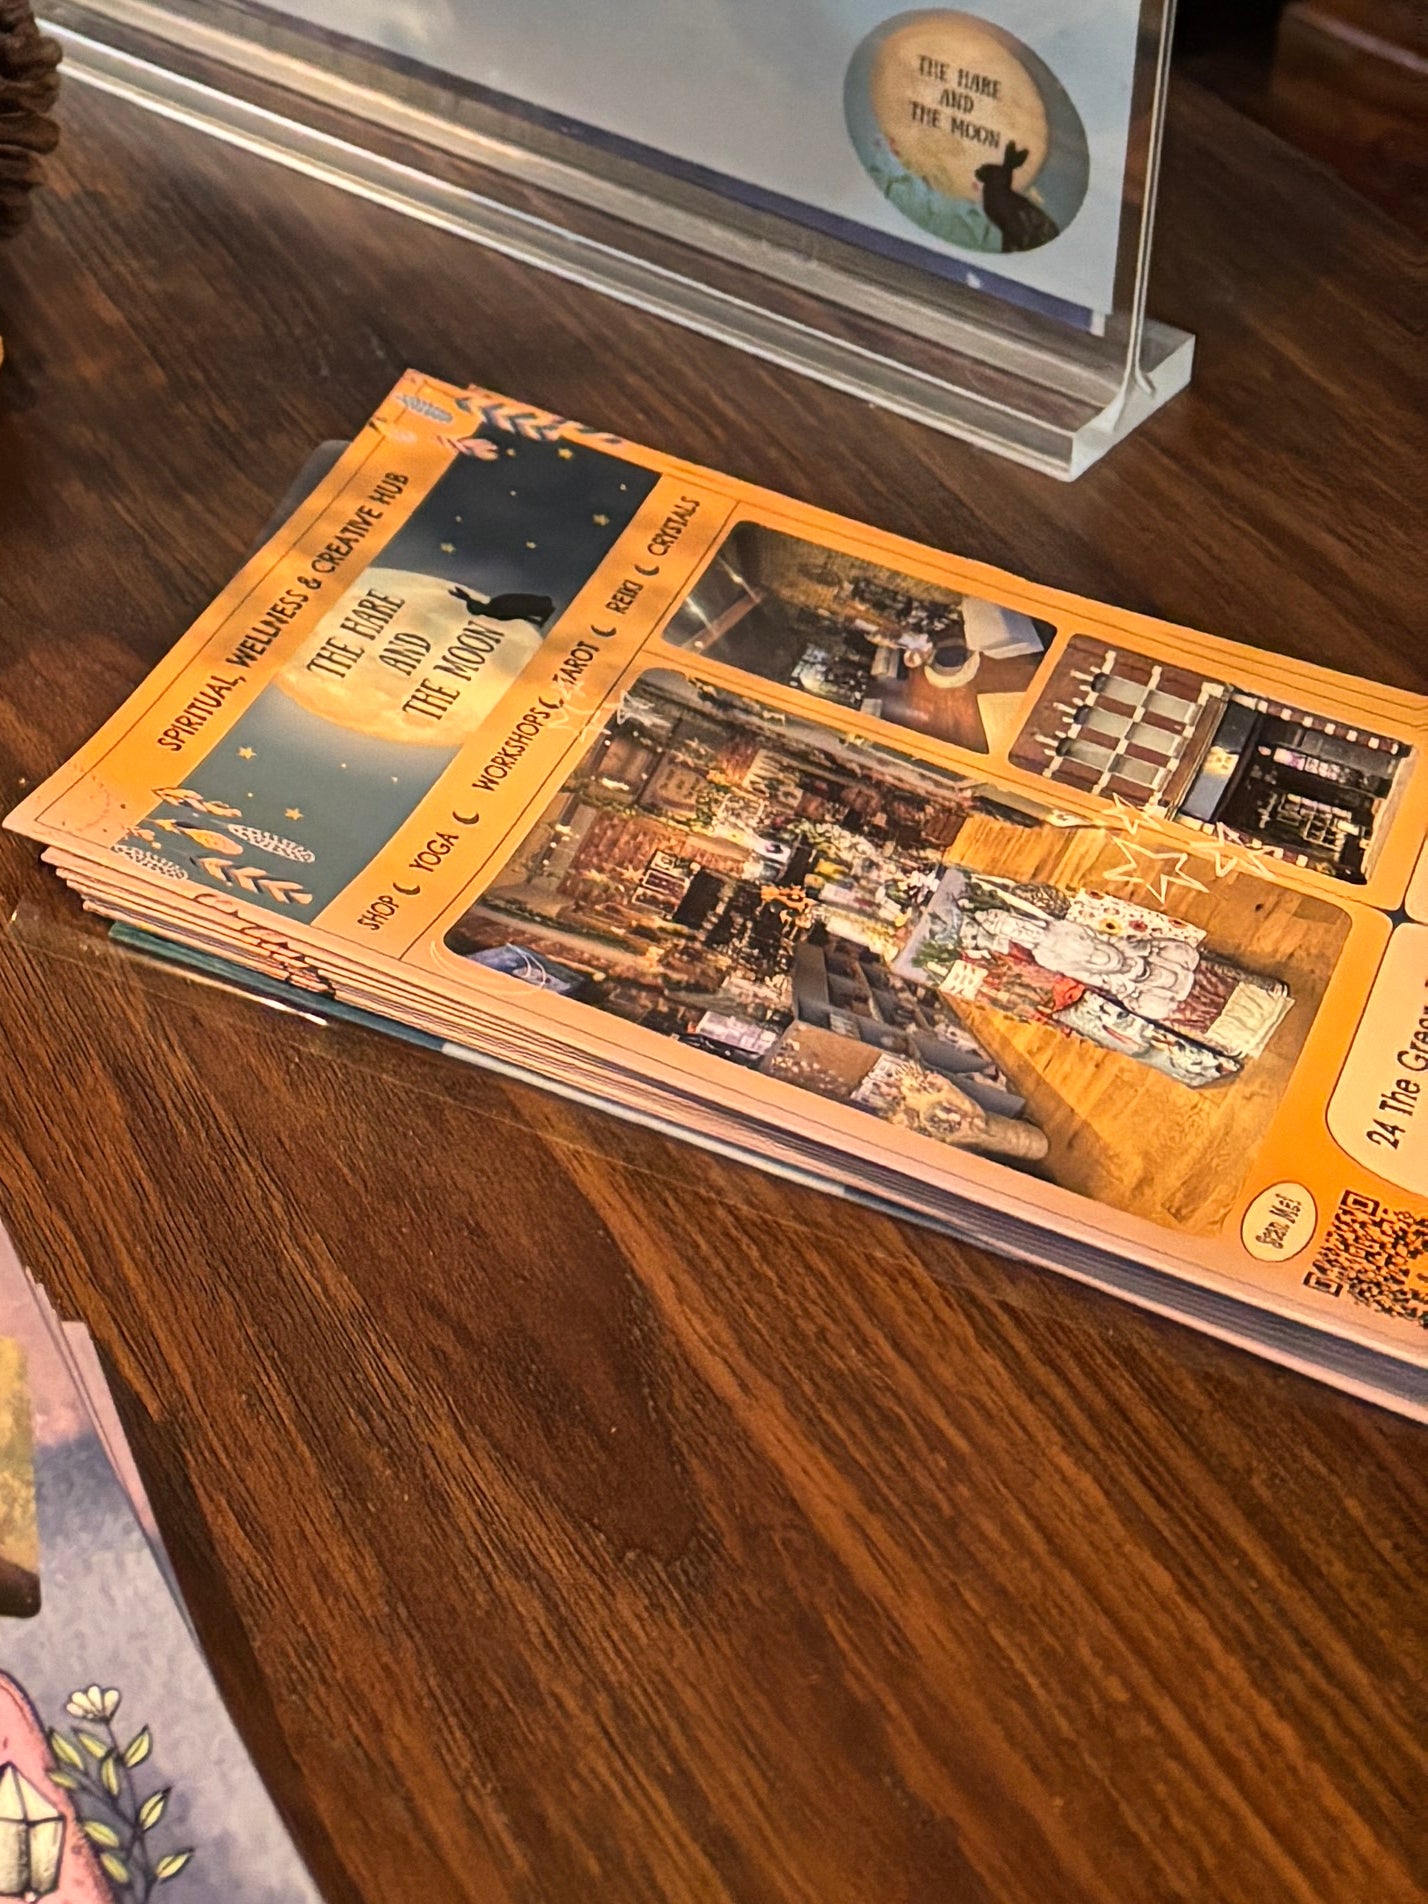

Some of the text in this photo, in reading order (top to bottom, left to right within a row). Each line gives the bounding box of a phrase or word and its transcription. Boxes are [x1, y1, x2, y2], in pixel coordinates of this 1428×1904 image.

[918, 54, 1002, 100] THE HARE
[939, 88, 974, 114] AND
[909, 101, 1001, 149] THE MOON
[157, 471, 409, 752] SPIRITUAL, WELLNESS & CREATIVE HUB
[306, 588, 405, 679] THE HARE
[378, 632, 432, 676] AND
[402, 620, 505, 721] THE MOON
[357, 495, 701, 930] SHOP YOGA WORKSHOPS TAROT REIKI CRYSTALS
[1366, 1006, 1428, 1150] 24 The Gree
[1255, 1220, 1291, 1250] Scan
